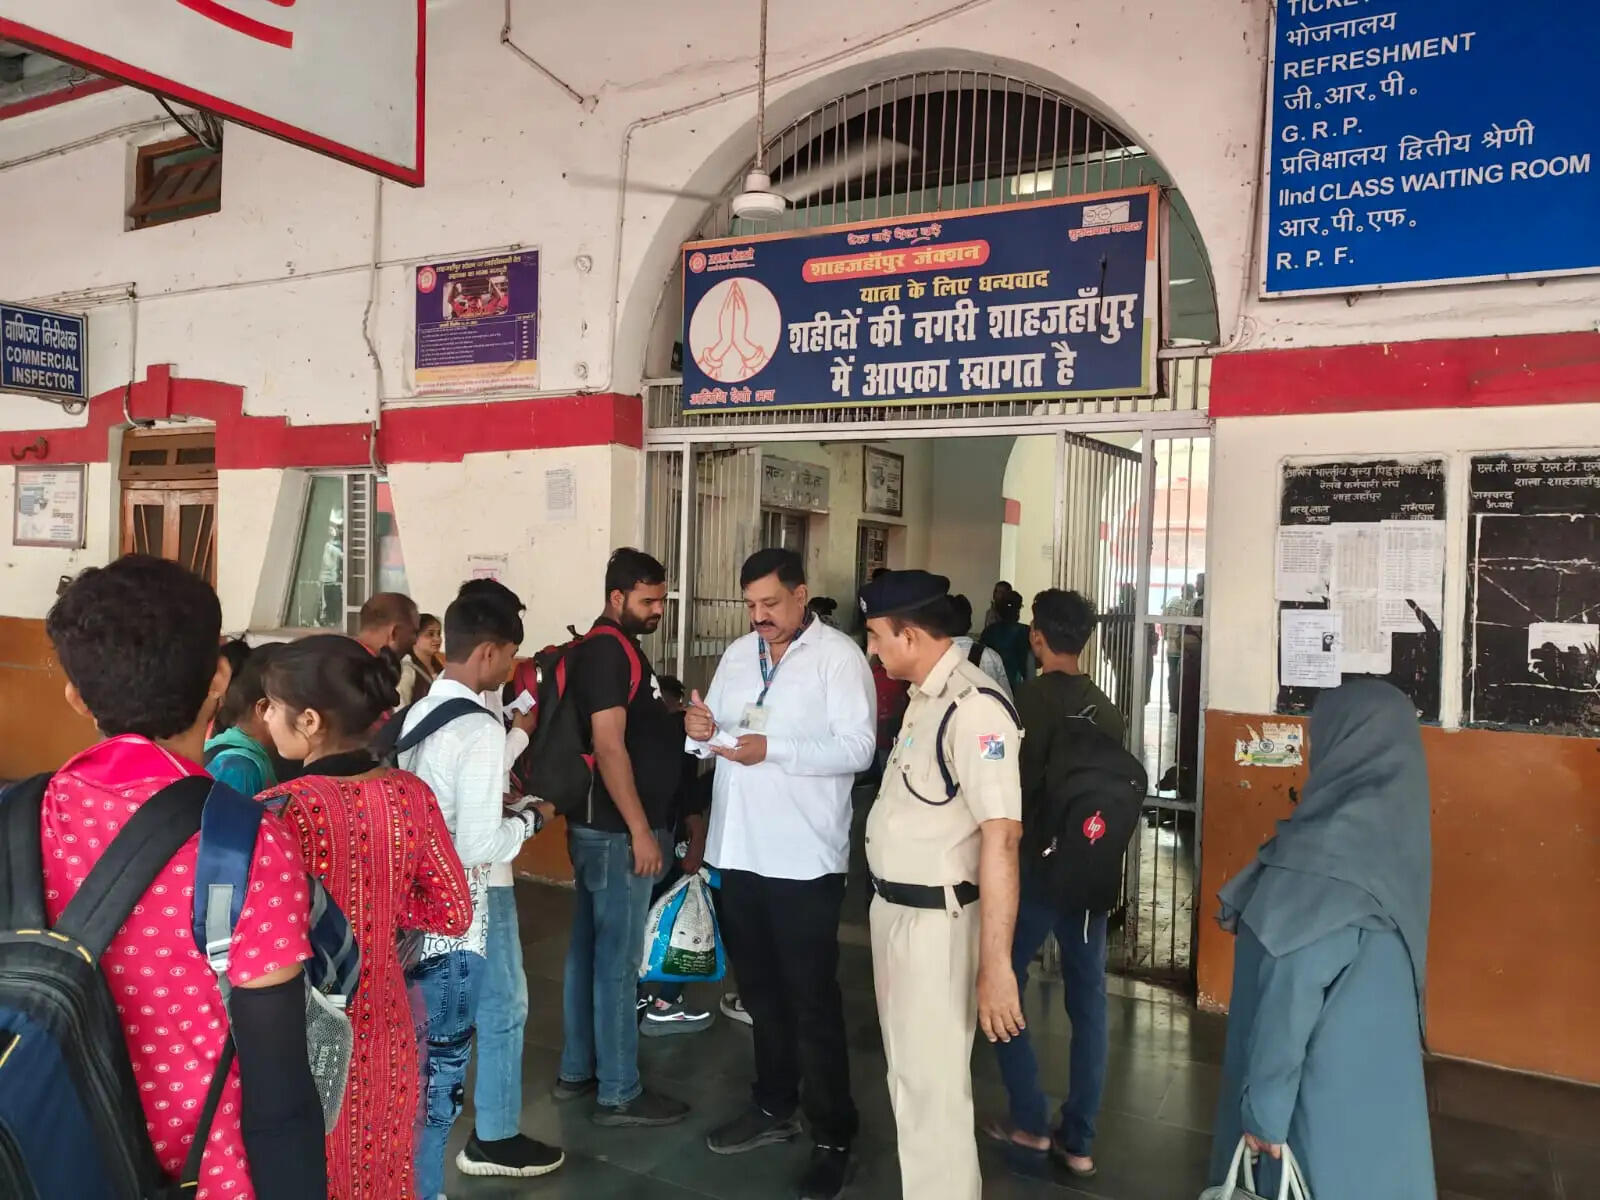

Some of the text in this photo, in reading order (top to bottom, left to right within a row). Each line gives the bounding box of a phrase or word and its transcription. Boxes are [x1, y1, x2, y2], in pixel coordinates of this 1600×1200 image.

[1287, 0, 1369, 16] TICK
[1286, 12, 1398, 46] भोजनालय
[1283, 32, 1476, 80] REFRESHMENT
[1281, 119, 1535, 175] प्रतिक्षालय द्वितीय श्रेणी
[1319, 177, 1394, 202] CLASS
[1401, 164, 1503, 193] WAITING
[1510, 153, 1591, 181] ROOM
[912, 245, 981, 265] जंक्शन
[859, 270, 1051, 303] यात्रा के लिए धन्यवाद
[5, 313, 78, 351] वाणिज्य निरीक्षक
[788, 286, 1138, 354] शहीदों की नगरी शाहजहाँपुर
[6, 345, 79, 372] COMMERCIAL
[830, 340, 1077, 397] में आपका स्वागत है
[12, 366, 75, 390] INSPECTOR
